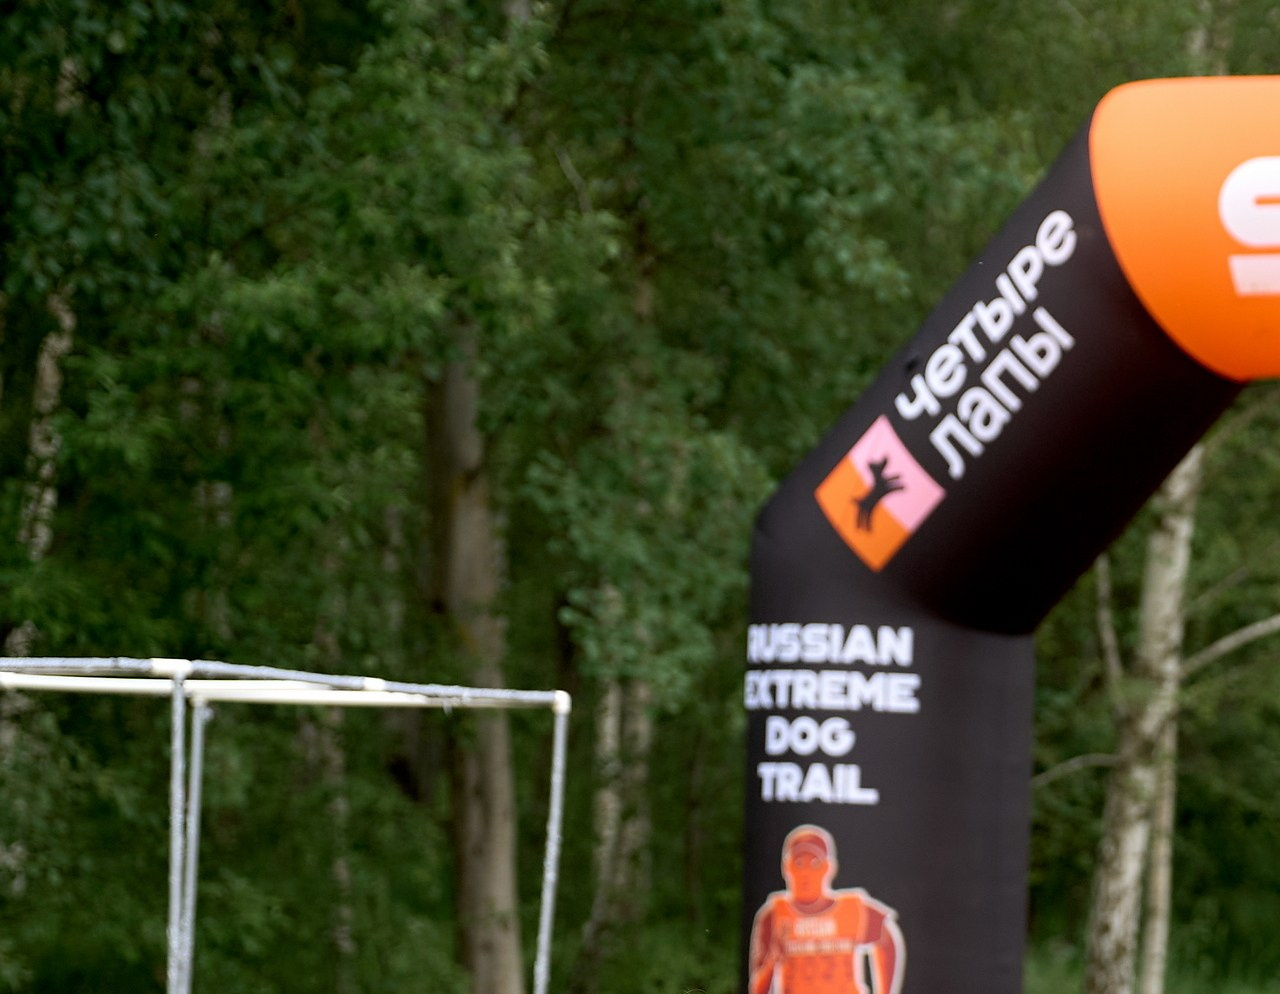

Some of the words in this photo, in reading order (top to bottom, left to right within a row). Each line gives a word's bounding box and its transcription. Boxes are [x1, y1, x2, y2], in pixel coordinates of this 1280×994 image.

[894, 209, 1078, 421] четыре
[929, 307, 1076, 481] лапы
[744, 669, 921, 713] EXTREME
[764, 716, 856, 757] DOG
[757, 762, 880, 805] TRAIL
